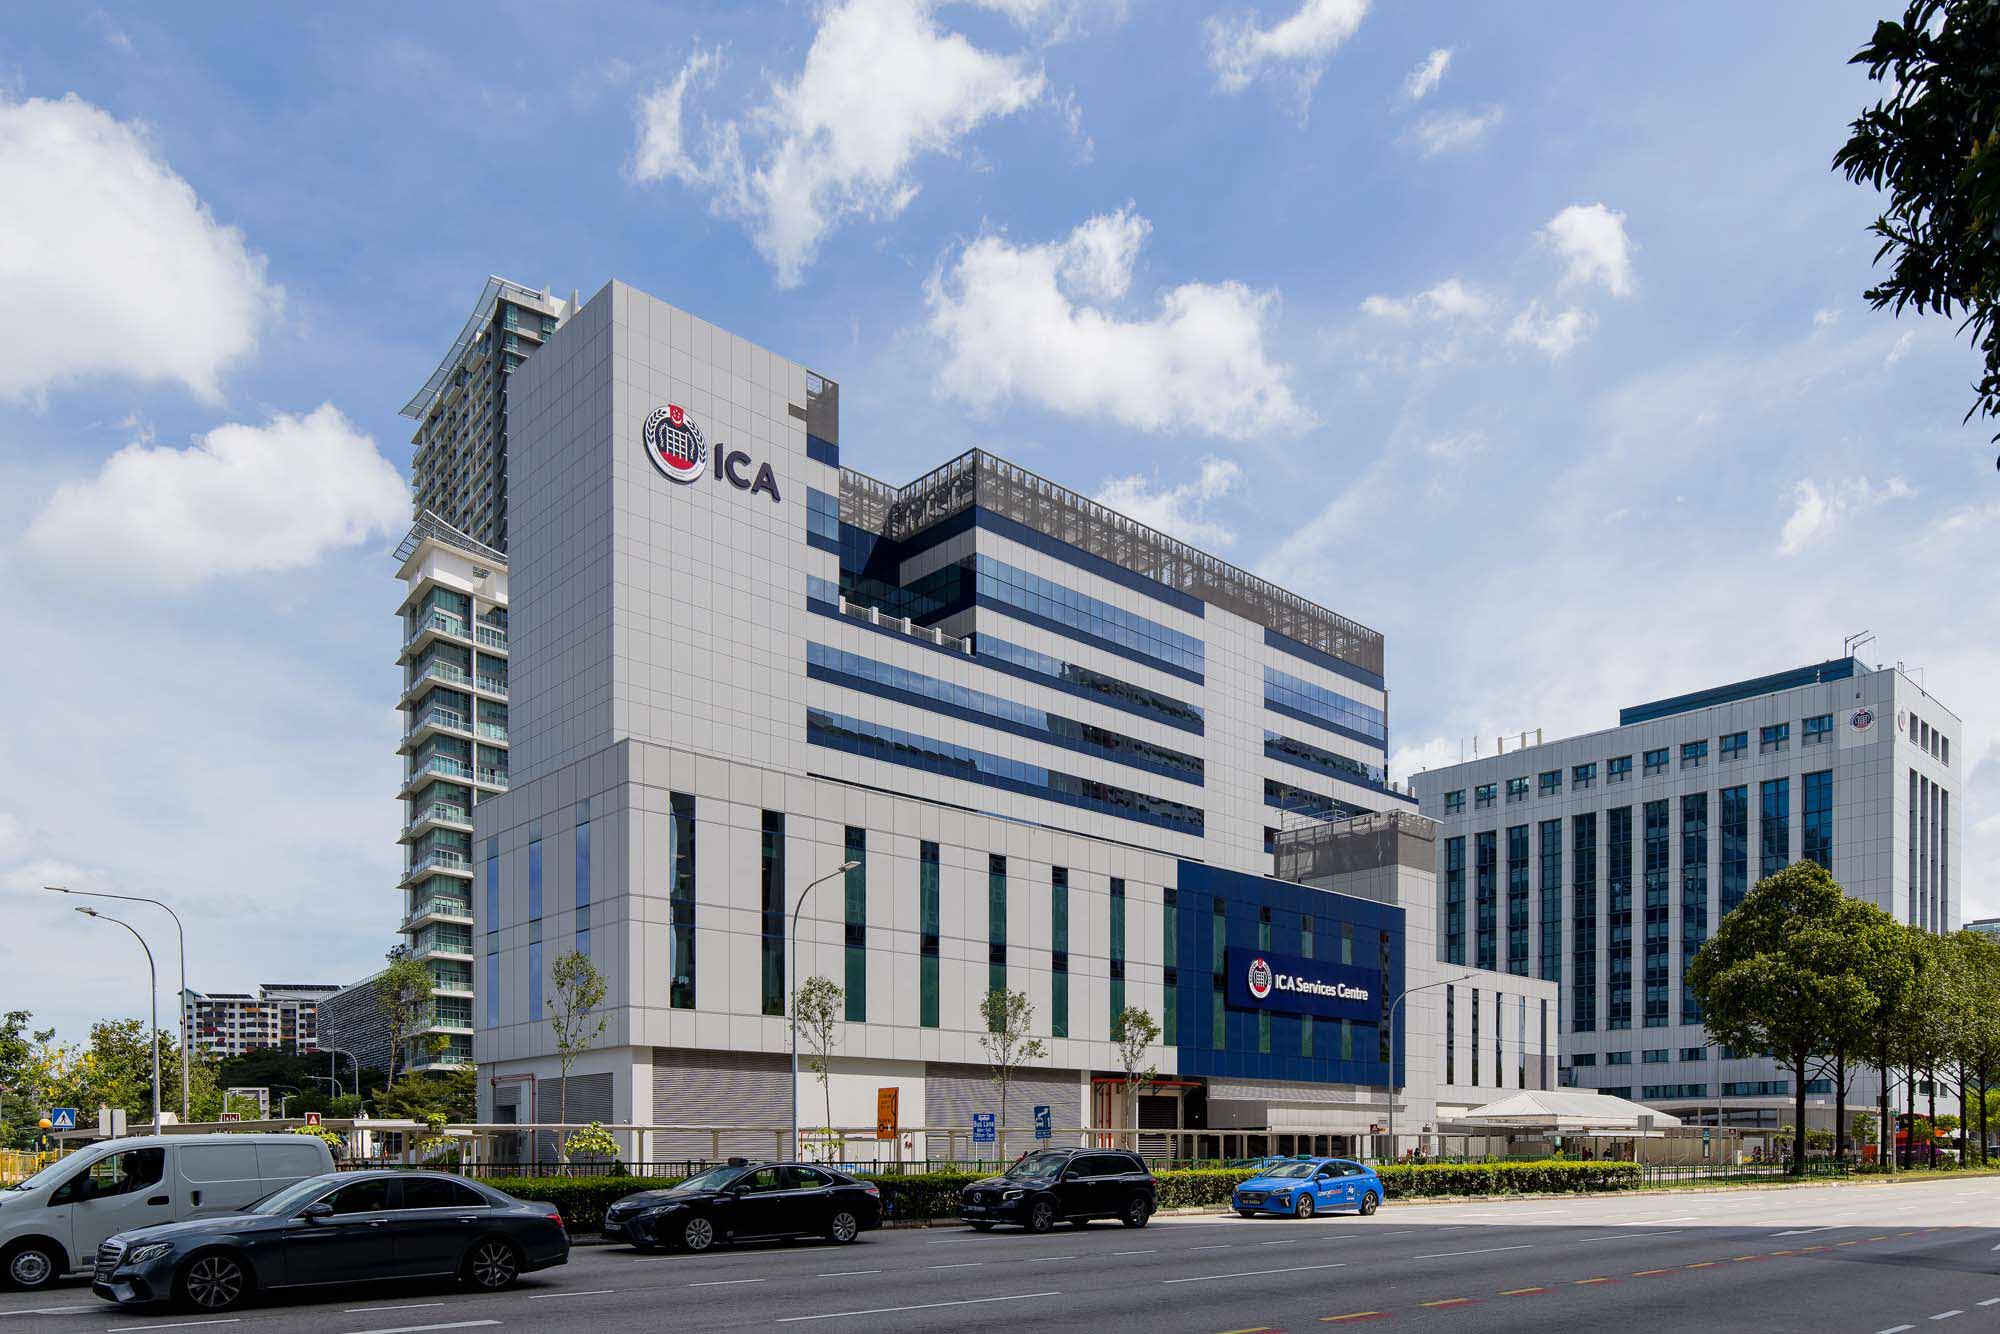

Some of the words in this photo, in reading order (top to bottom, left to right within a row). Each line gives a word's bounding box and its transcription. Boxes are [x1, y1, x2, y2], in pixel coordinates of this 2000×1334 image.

[714, 443, 782, 504] ICA
[1275, 974, 1296, 991] ICA
[1296, 977, 1337, 997] Services
[1337, 983, 1369, 1001] Centre
